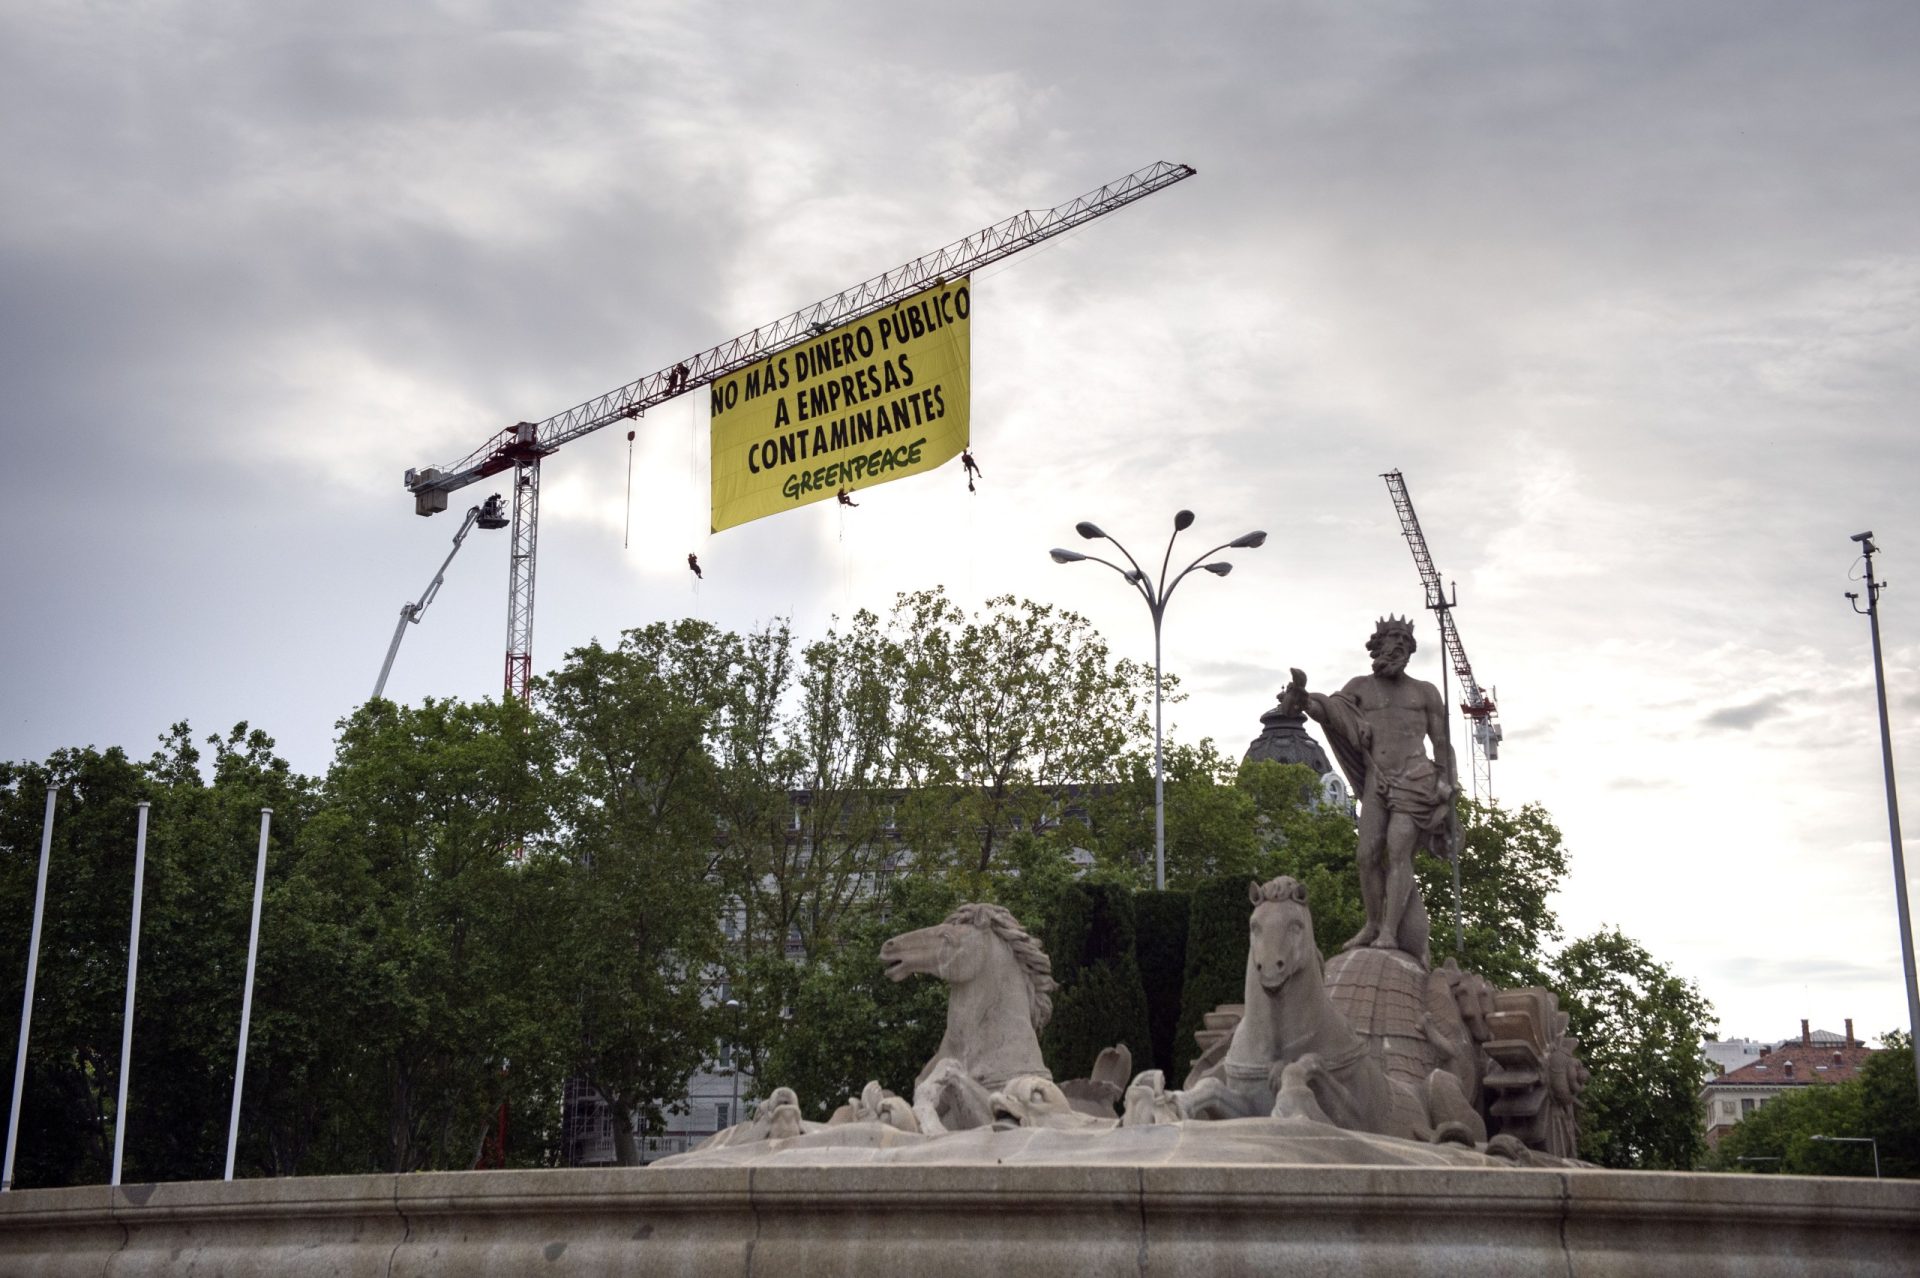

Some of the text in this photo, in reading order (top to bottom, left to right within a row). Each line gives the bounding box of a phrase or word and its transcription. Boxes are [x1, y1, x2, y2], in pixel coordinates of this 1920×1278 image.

[711, 286, 970, 417] NO MÁS DINERO PÚBLICO
[774, 354, 913, 428] A EMPRESAS
[749, 385, 945, 474] CONTAMINANTES
[783, 438, 926, 499] GREENPEACE
